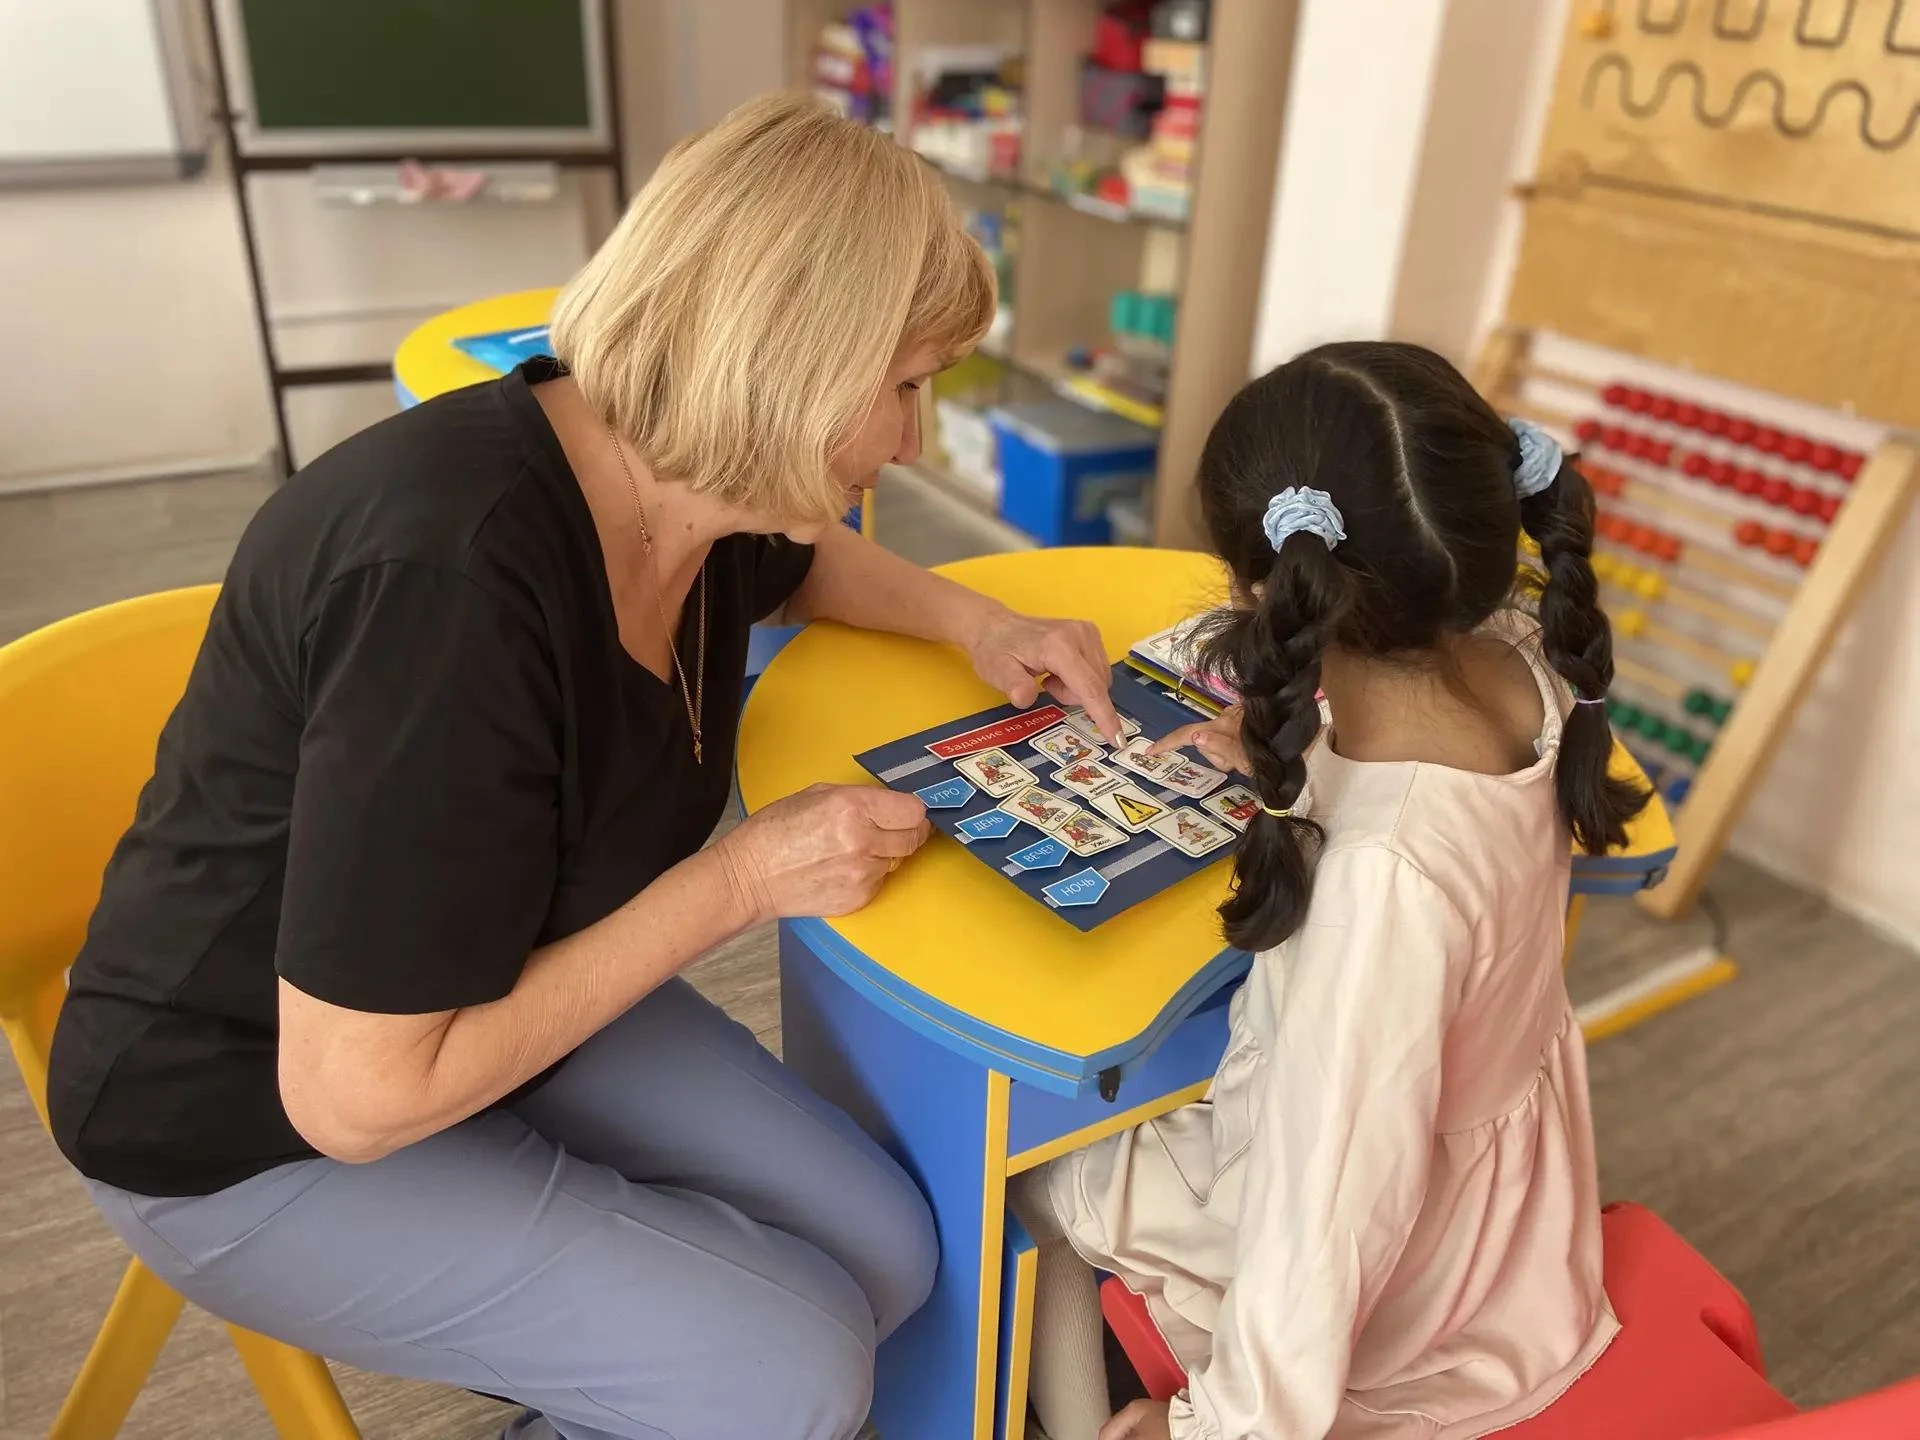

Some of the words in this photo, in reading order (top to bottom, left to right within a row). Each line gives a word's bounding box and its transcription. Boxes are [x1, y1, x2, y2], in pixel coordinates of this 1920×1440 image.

[942, 730, 1003, 754] Задание
[1005, 723, 1023, 734] на
[1025, 712, 1057, 728] день
[998, 777, 1024, 790] Завтрак
[929, 787, 960, 803] УТРО
[972, 815, 1004, 832] ДЕНЬ
[1023, 844, 1055, 863] ВЕЧЕР
[1062, 878, 1096, 897] НОЧЬ
